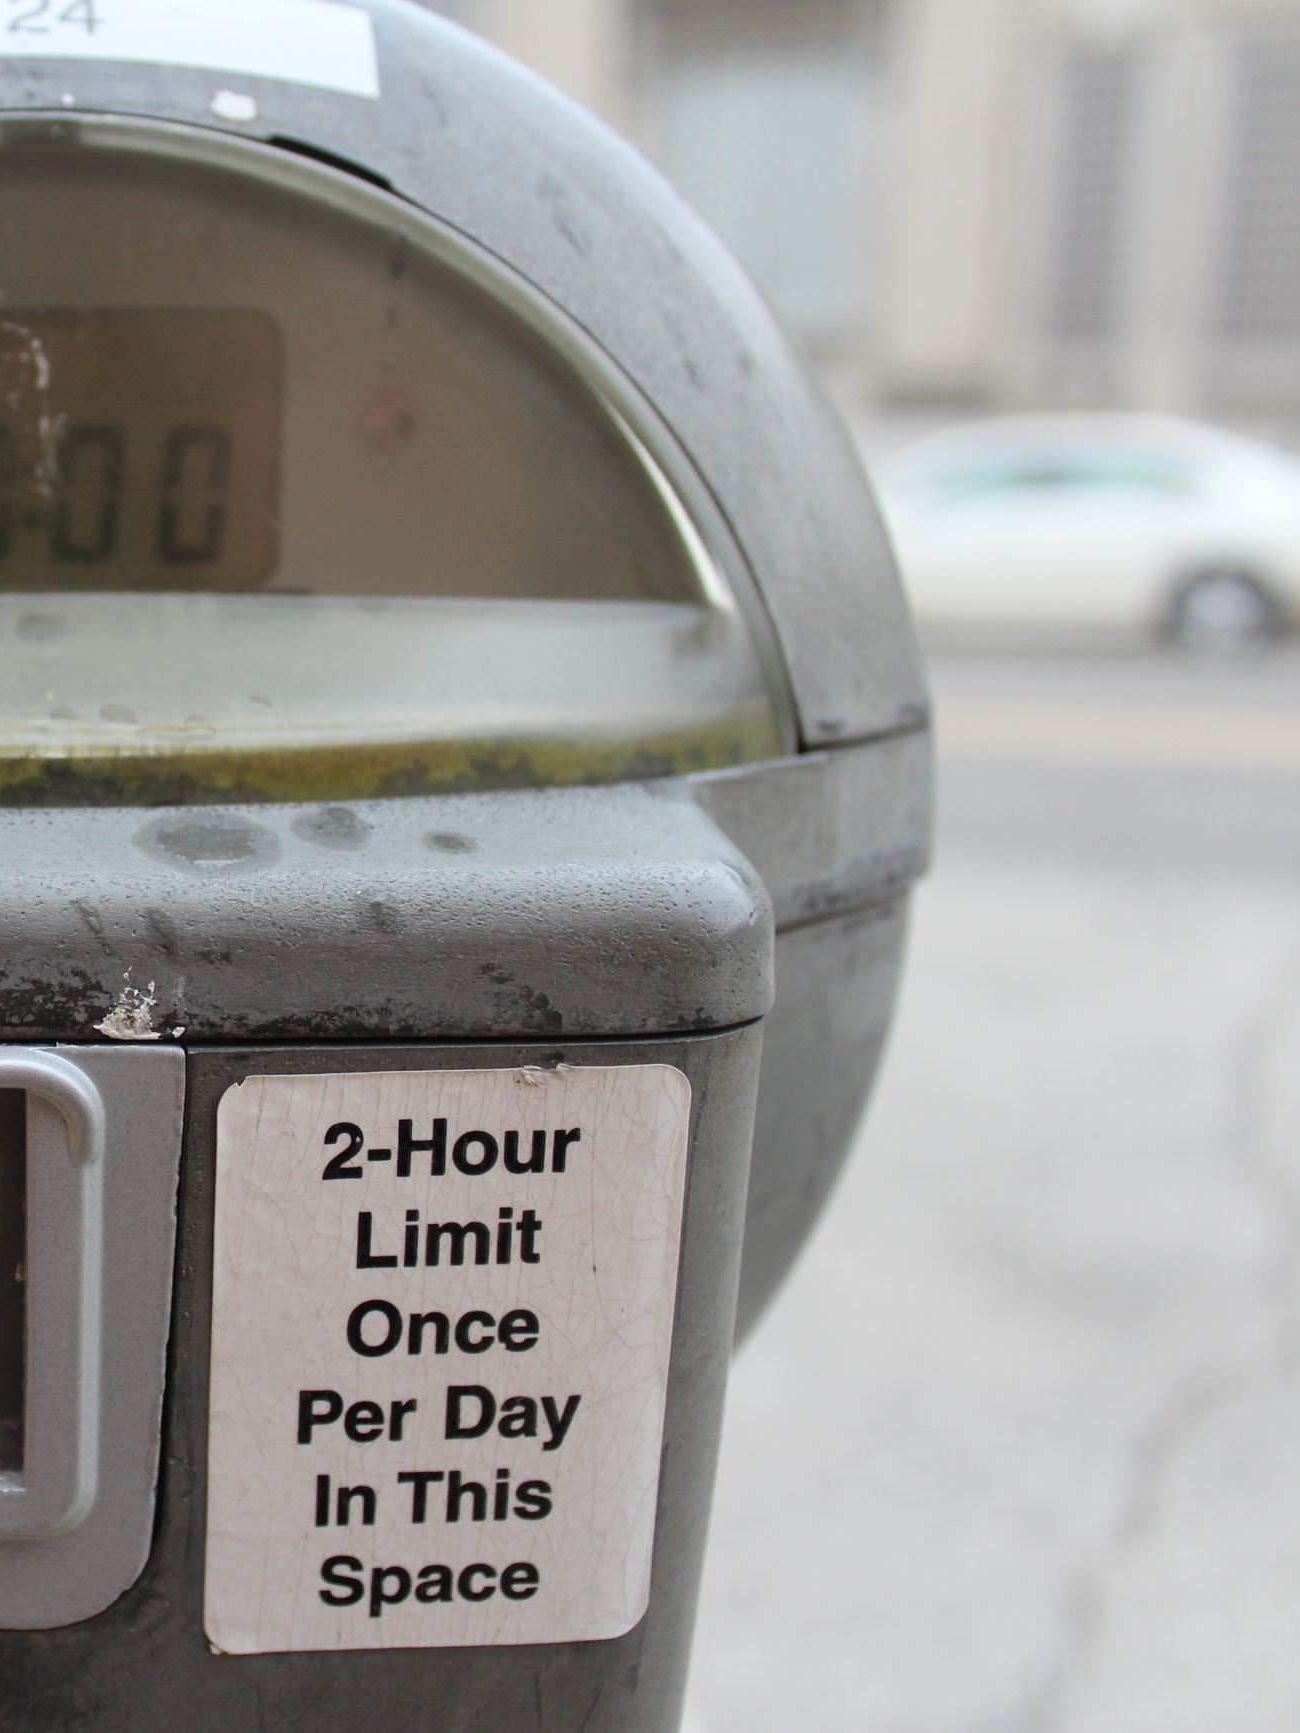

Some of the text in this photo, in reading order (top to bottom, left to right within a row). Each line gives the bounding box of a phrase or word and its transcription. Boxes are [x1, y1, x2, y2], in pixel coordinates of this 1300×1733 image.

[322, 1118, 580, 1180] 2-Hour
[356, 1207, 542, 1269] Limit
[347, 1300, 539, 1357] Once
[297, 1385, 581, 1451] Per Day
[316, 1468, 552, 1527] In This
[319, 1555, 539, 1618] Space
